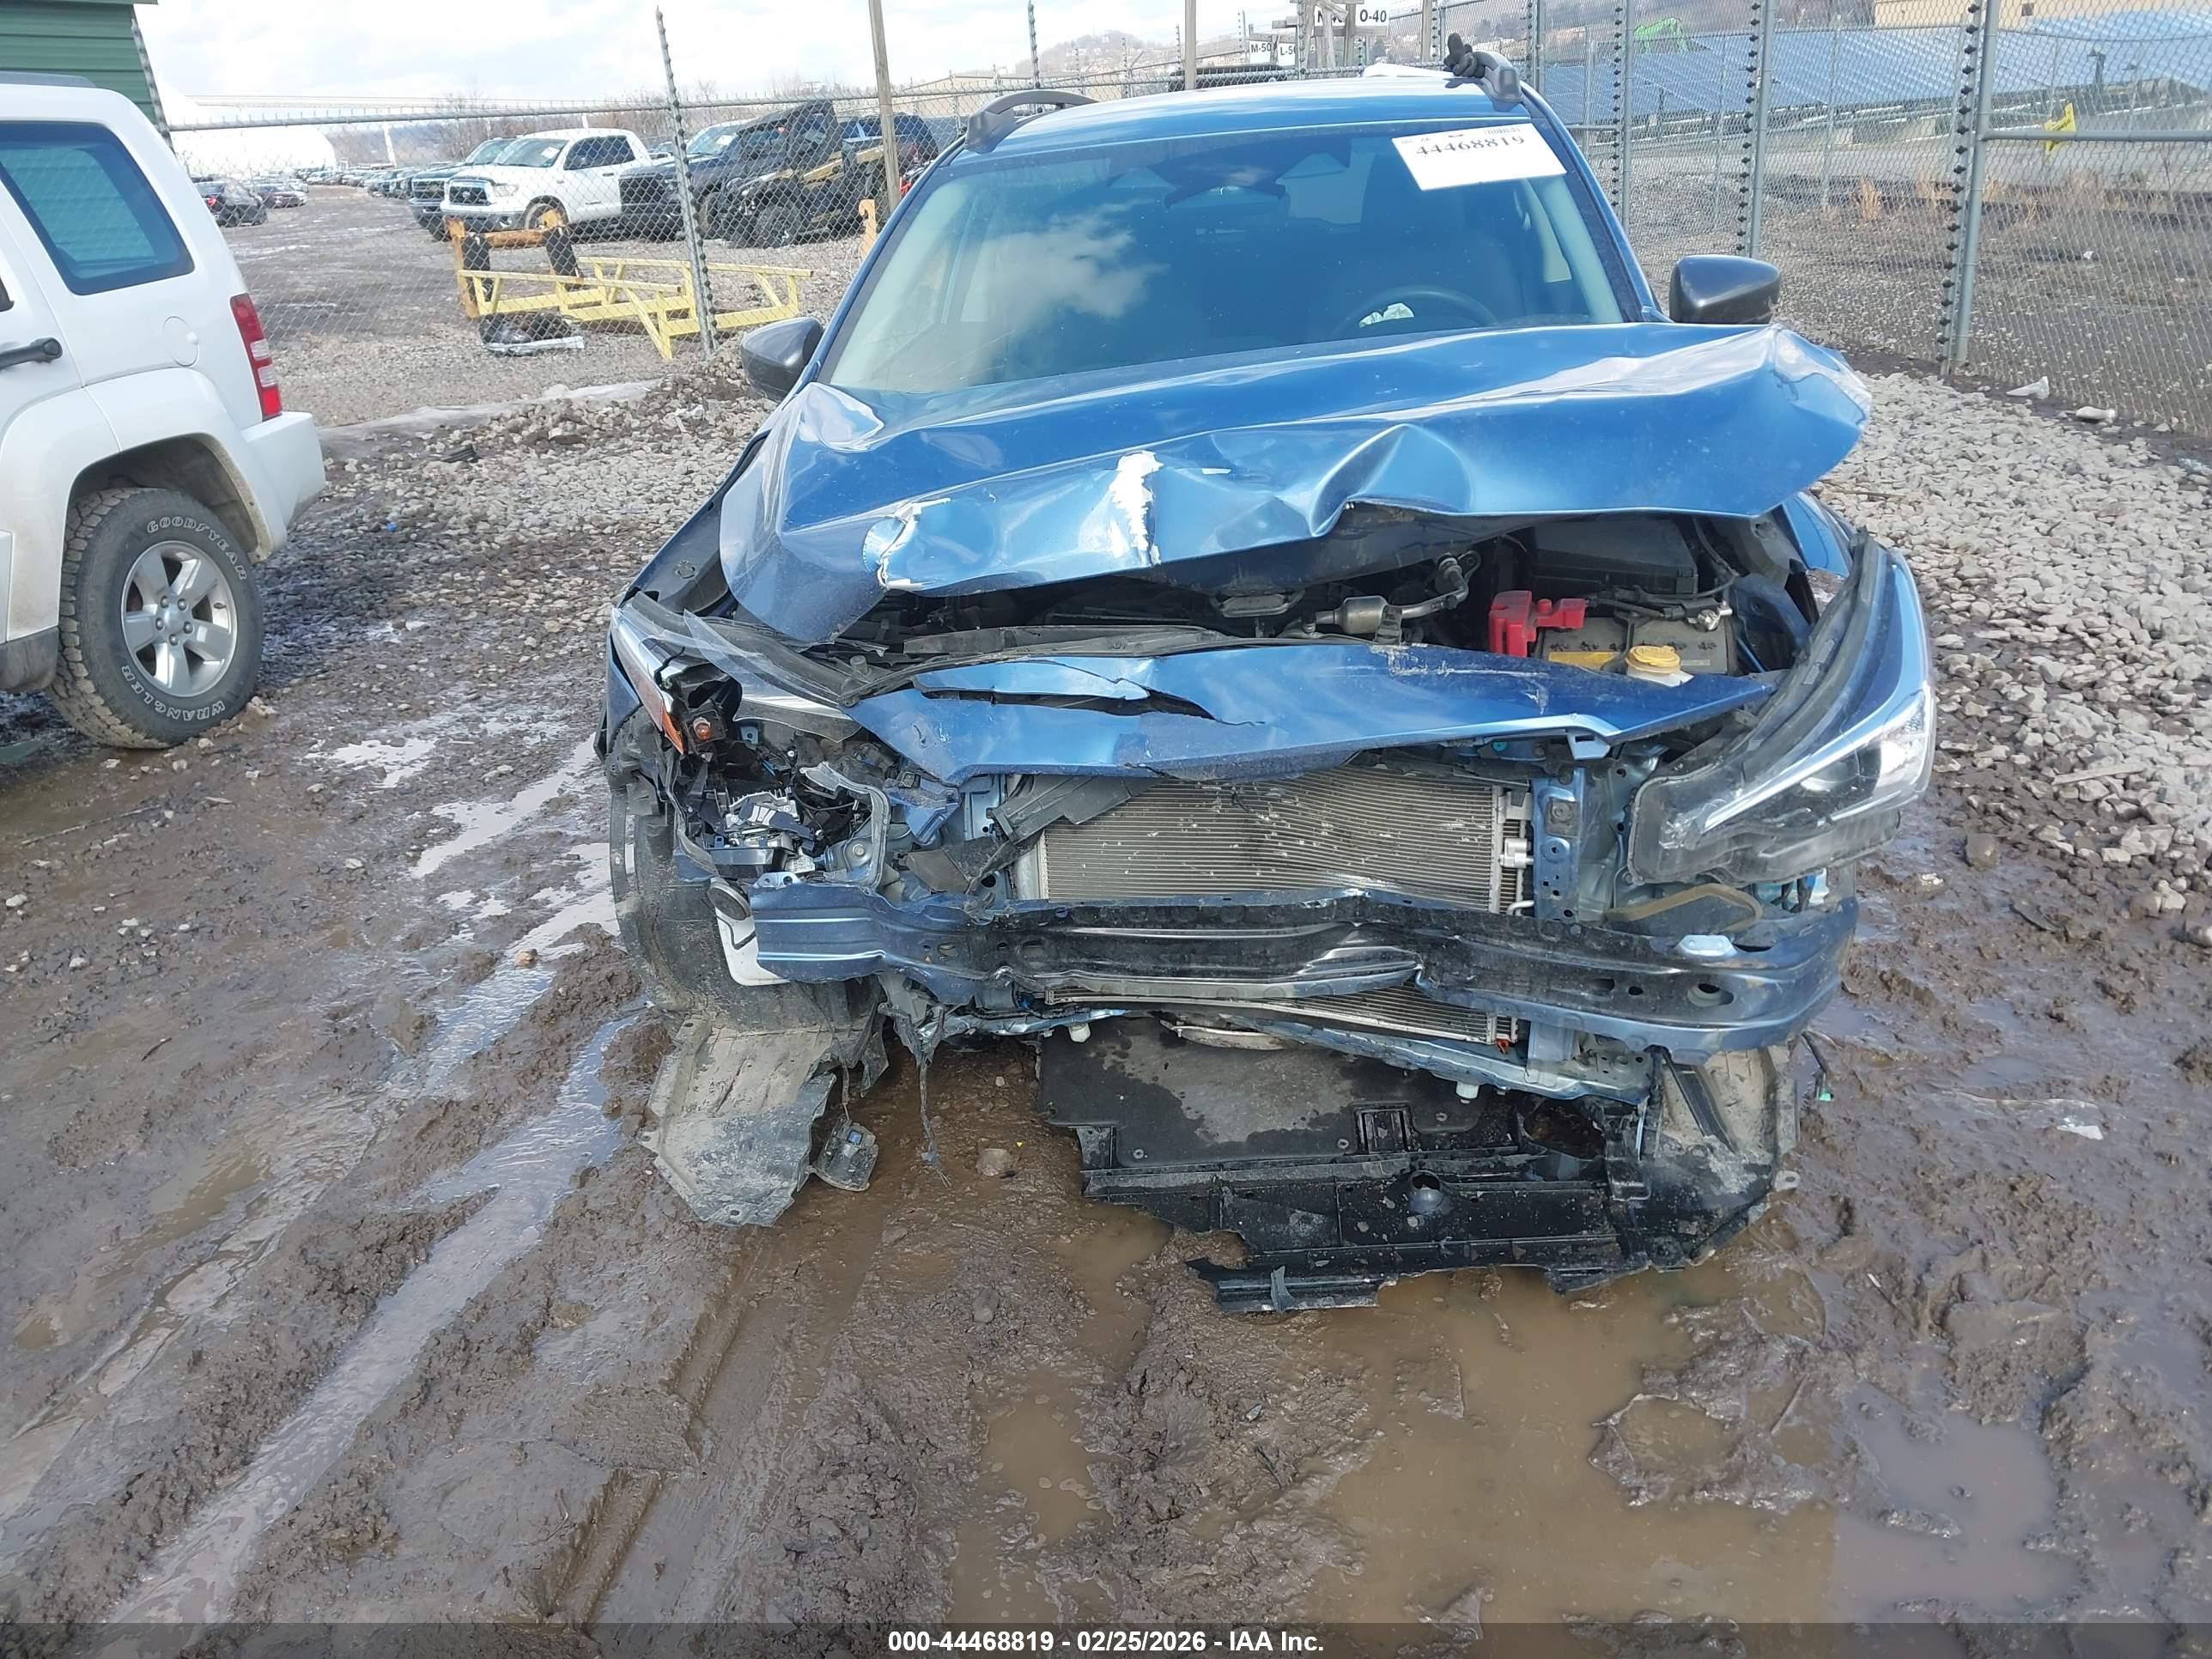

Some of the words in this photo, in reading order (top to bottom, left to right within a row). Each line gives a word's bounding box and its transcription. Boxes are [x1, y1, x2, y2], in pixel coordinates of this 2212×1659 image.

[1359, 9, 1387, 22] O-40
[1250, 42, 1272, 53] M-50
[1279, 45, 1296, 56] L-5
[1416, 135, 1525, 155] 44468819
[147, 516, 247, 580] GOODYEAR
[121, 665, 226, 721] WRANGLER
